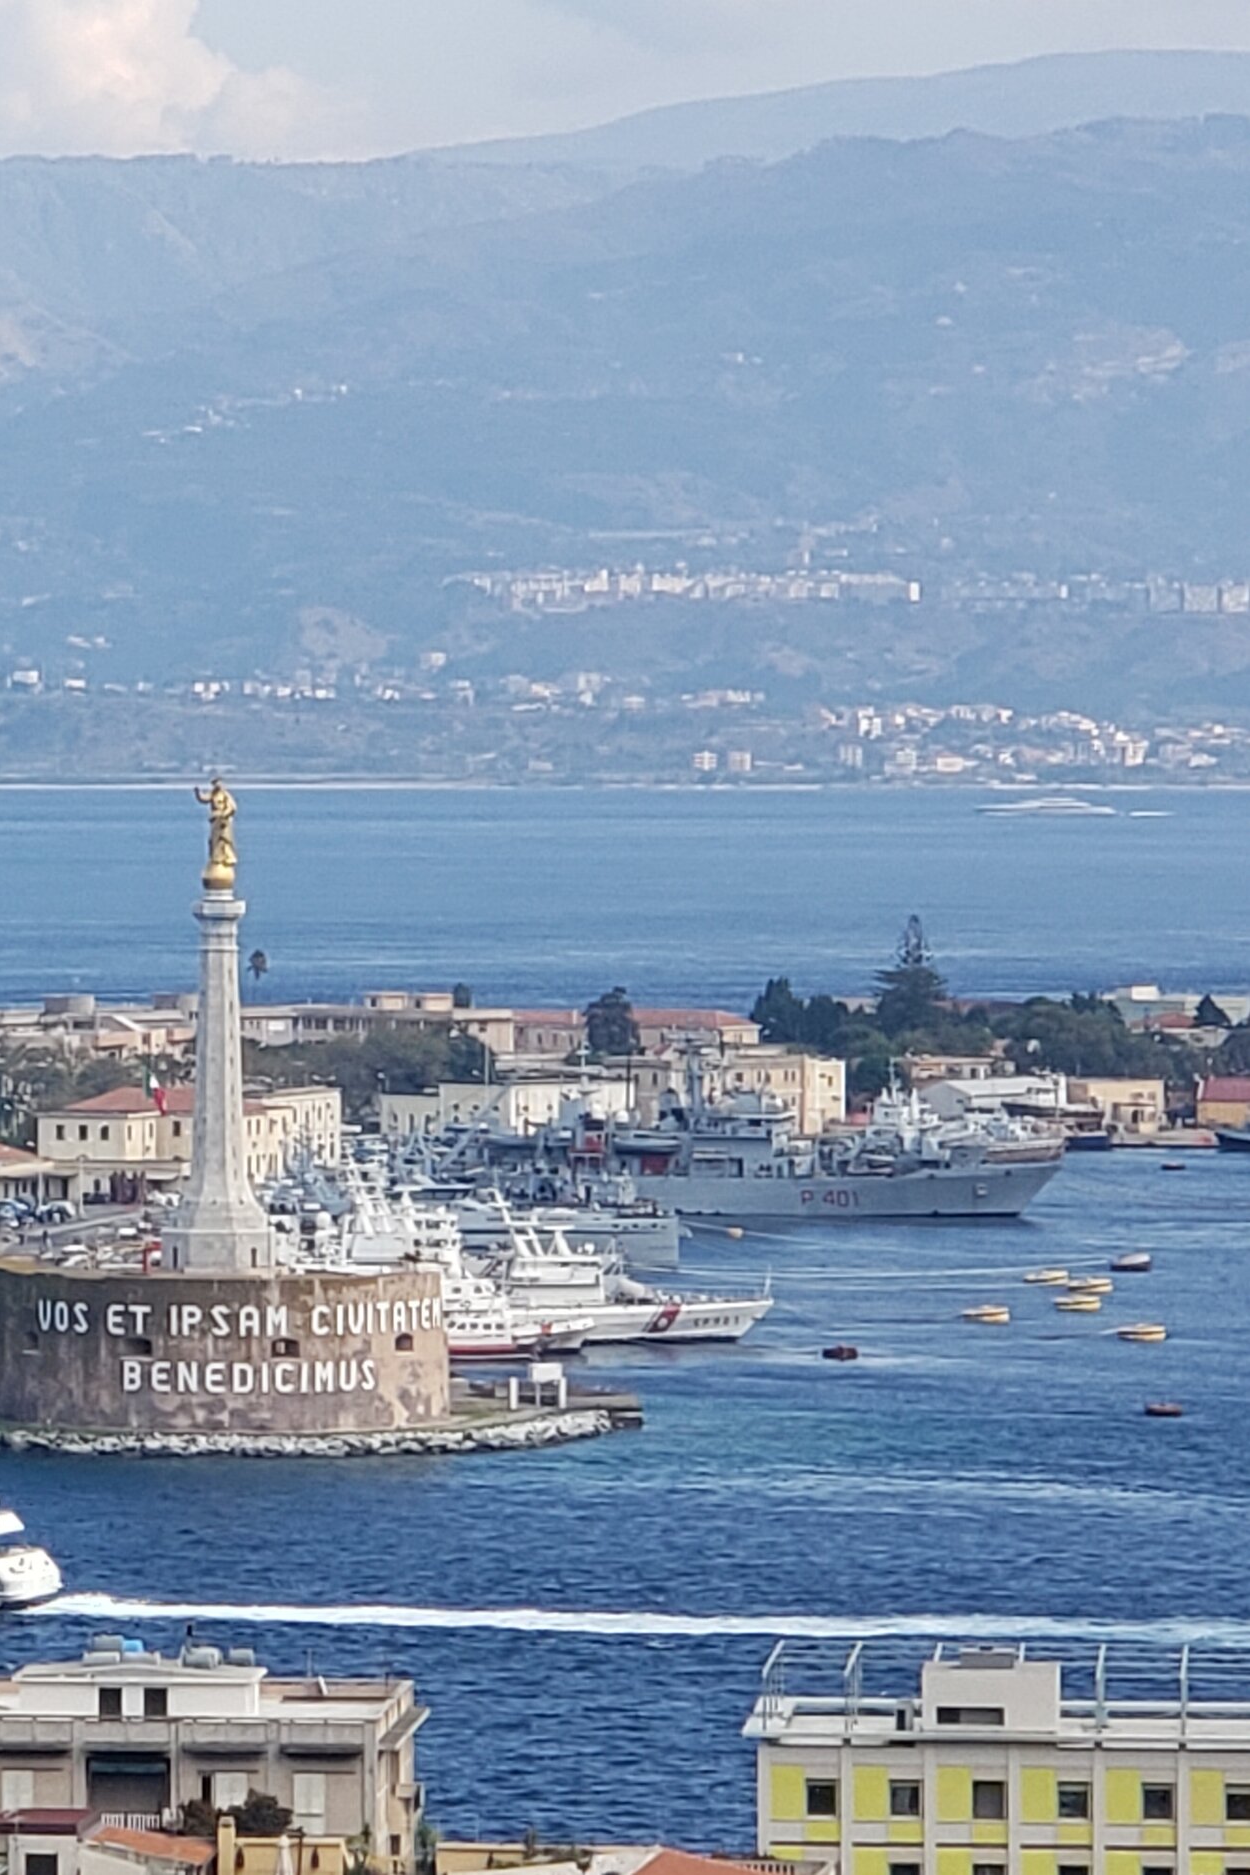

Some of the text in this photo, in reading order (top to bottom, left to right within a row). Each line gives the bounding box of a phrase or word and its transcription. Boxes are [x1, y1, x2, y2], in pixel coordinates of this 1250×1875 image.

[800, 1189, 859, 1208] P 401
[37, 1297, 441, 1338] VOS ET IPSAM CIVITATEM
[122, 1359, 377, 1393] BENEDICIMUS
